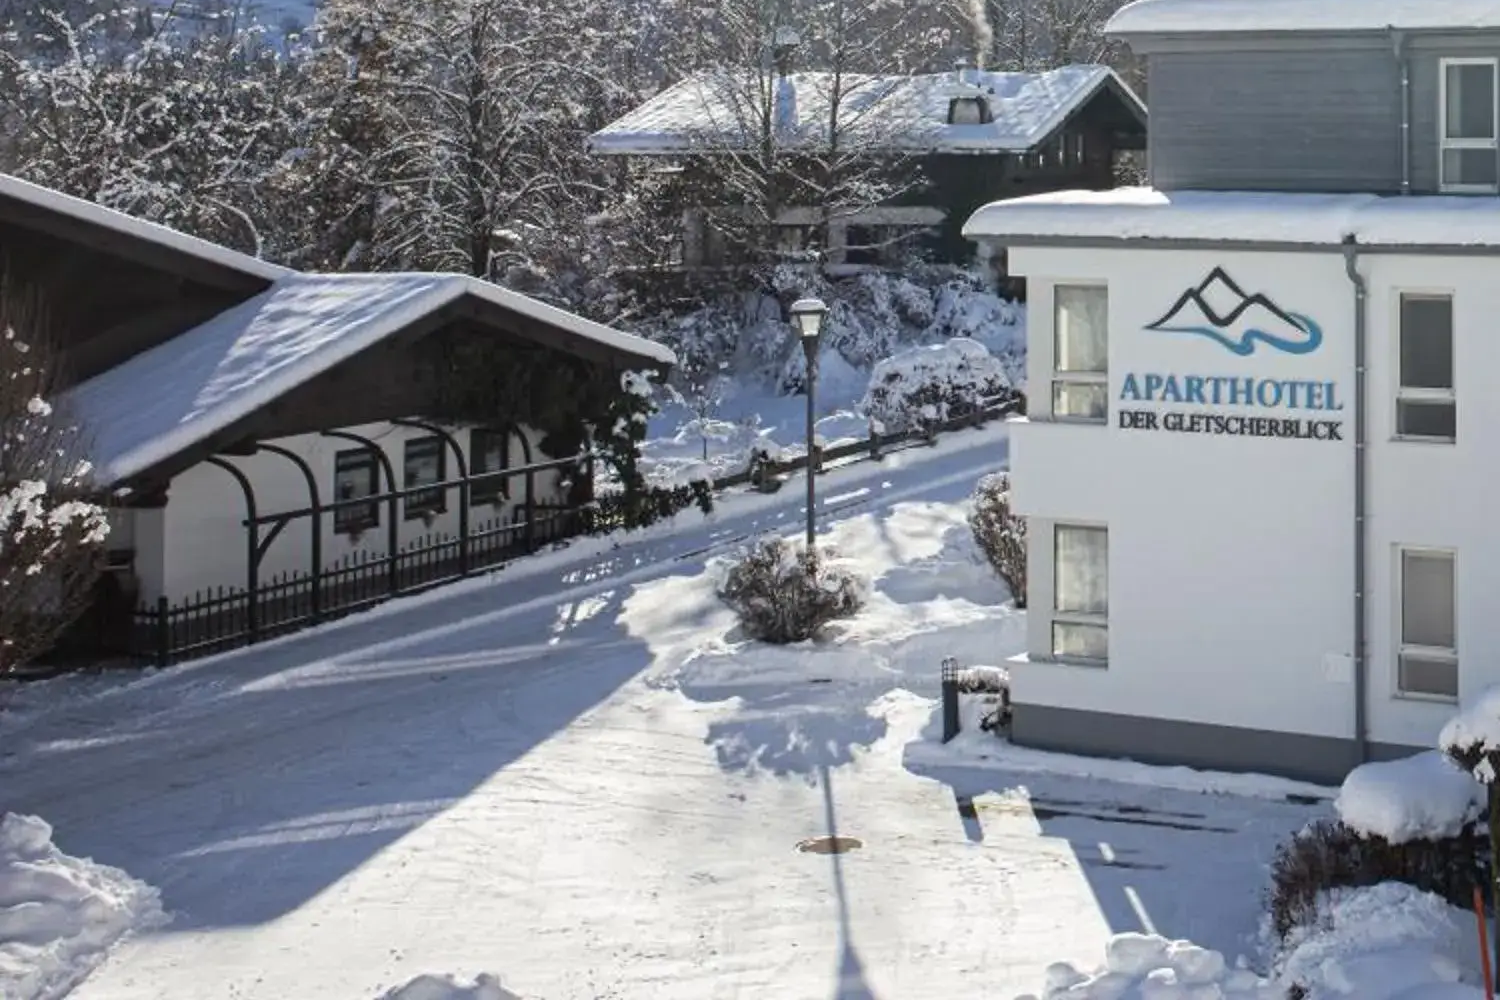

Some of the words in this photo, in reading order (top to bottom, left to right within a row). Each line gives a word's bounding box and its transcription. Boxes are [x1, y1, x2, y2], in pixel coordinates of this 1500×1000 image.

[1120, 373, 1343, 410] APARTHOTEL
[1119, 411, 1159, 430] DER
[1164, 413, 1343, 440] GLETSCHERBLICK
